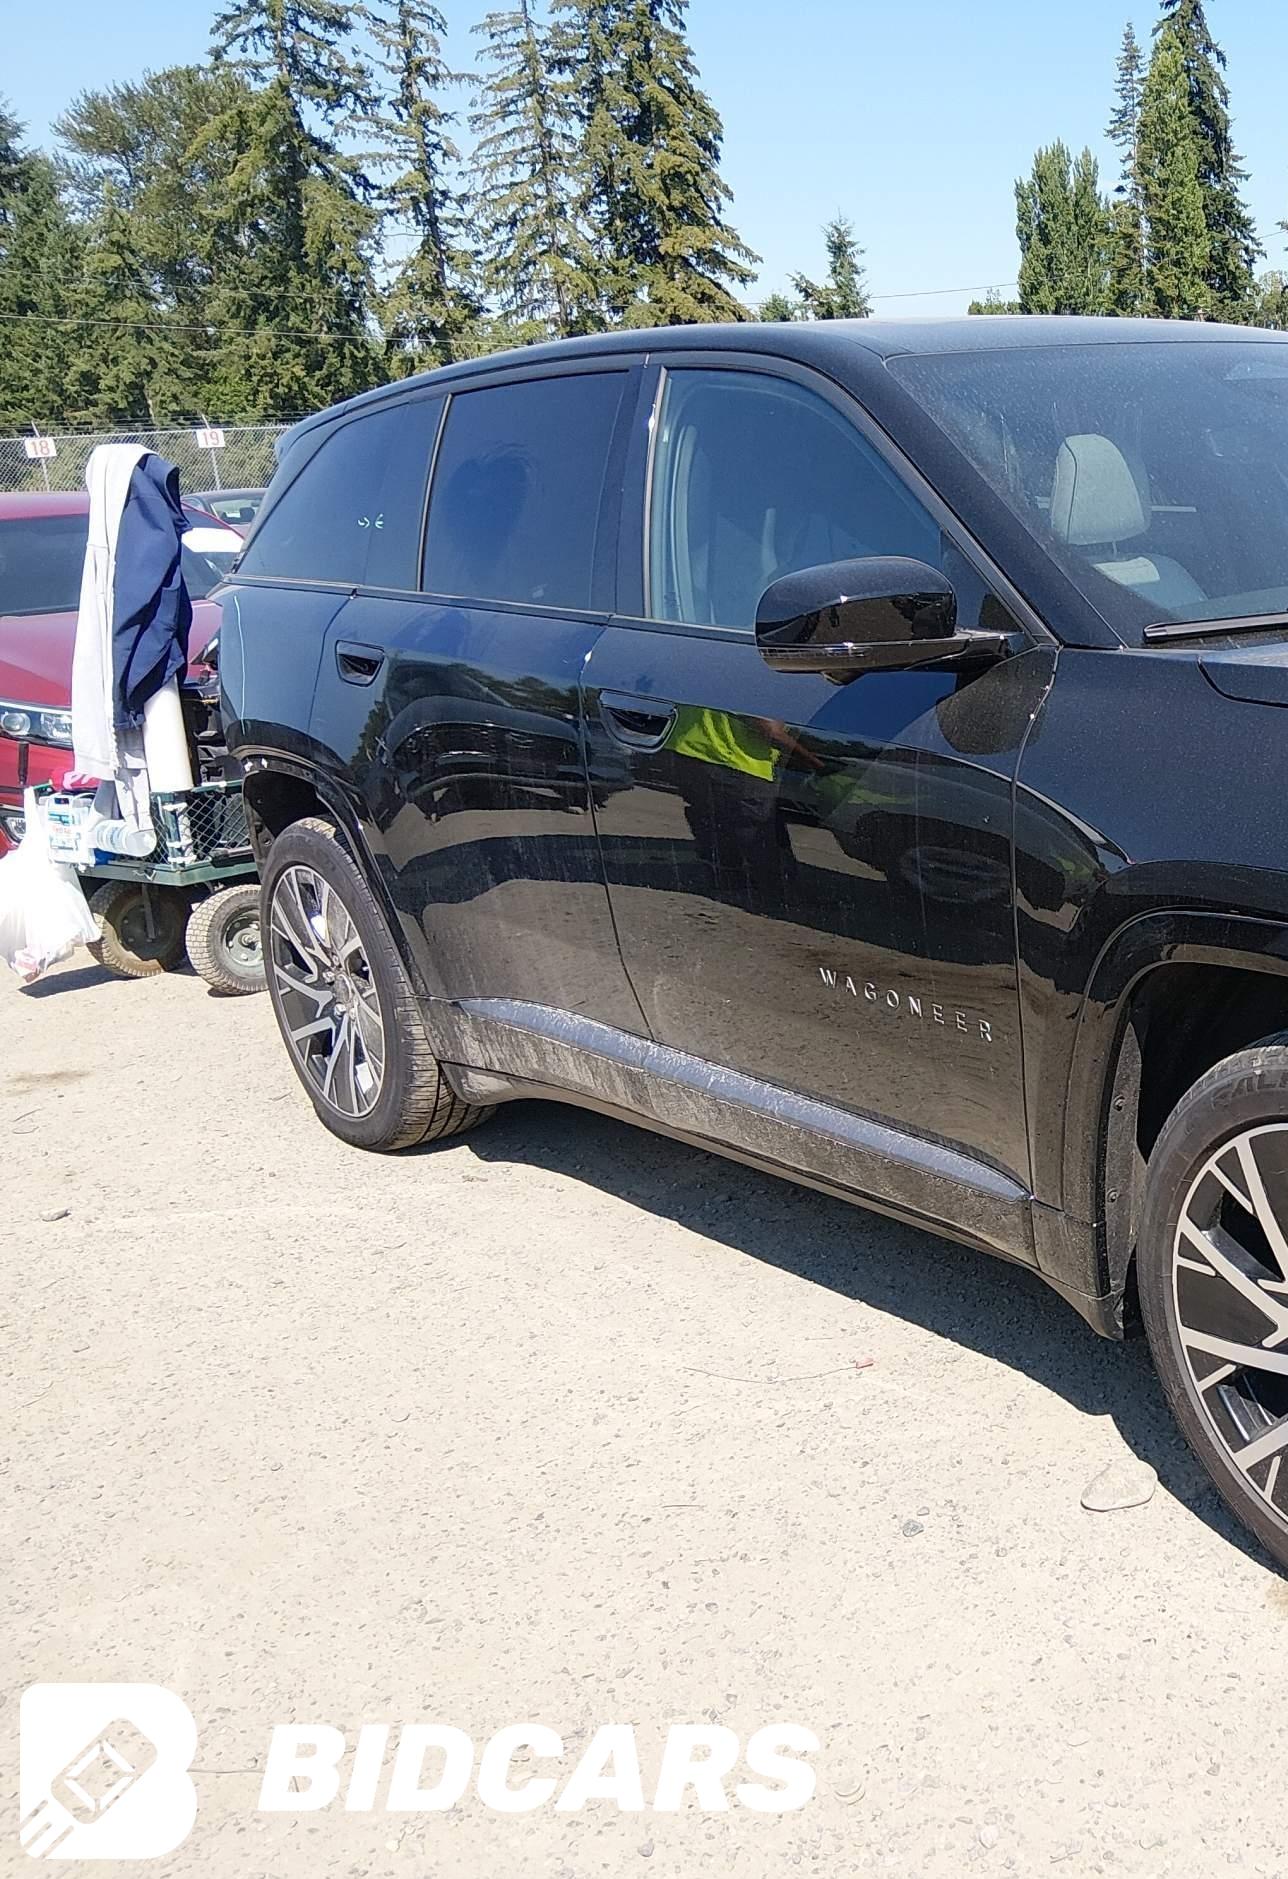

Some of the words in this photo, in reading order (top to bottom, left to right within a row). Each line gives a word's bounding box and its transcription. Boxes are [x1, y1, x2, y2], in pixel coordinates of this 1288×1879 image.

[203, 431, 219, 446] 19
[31, 440, 50, 456] 18
[819, 967, 992, 1042] WAGONEER
